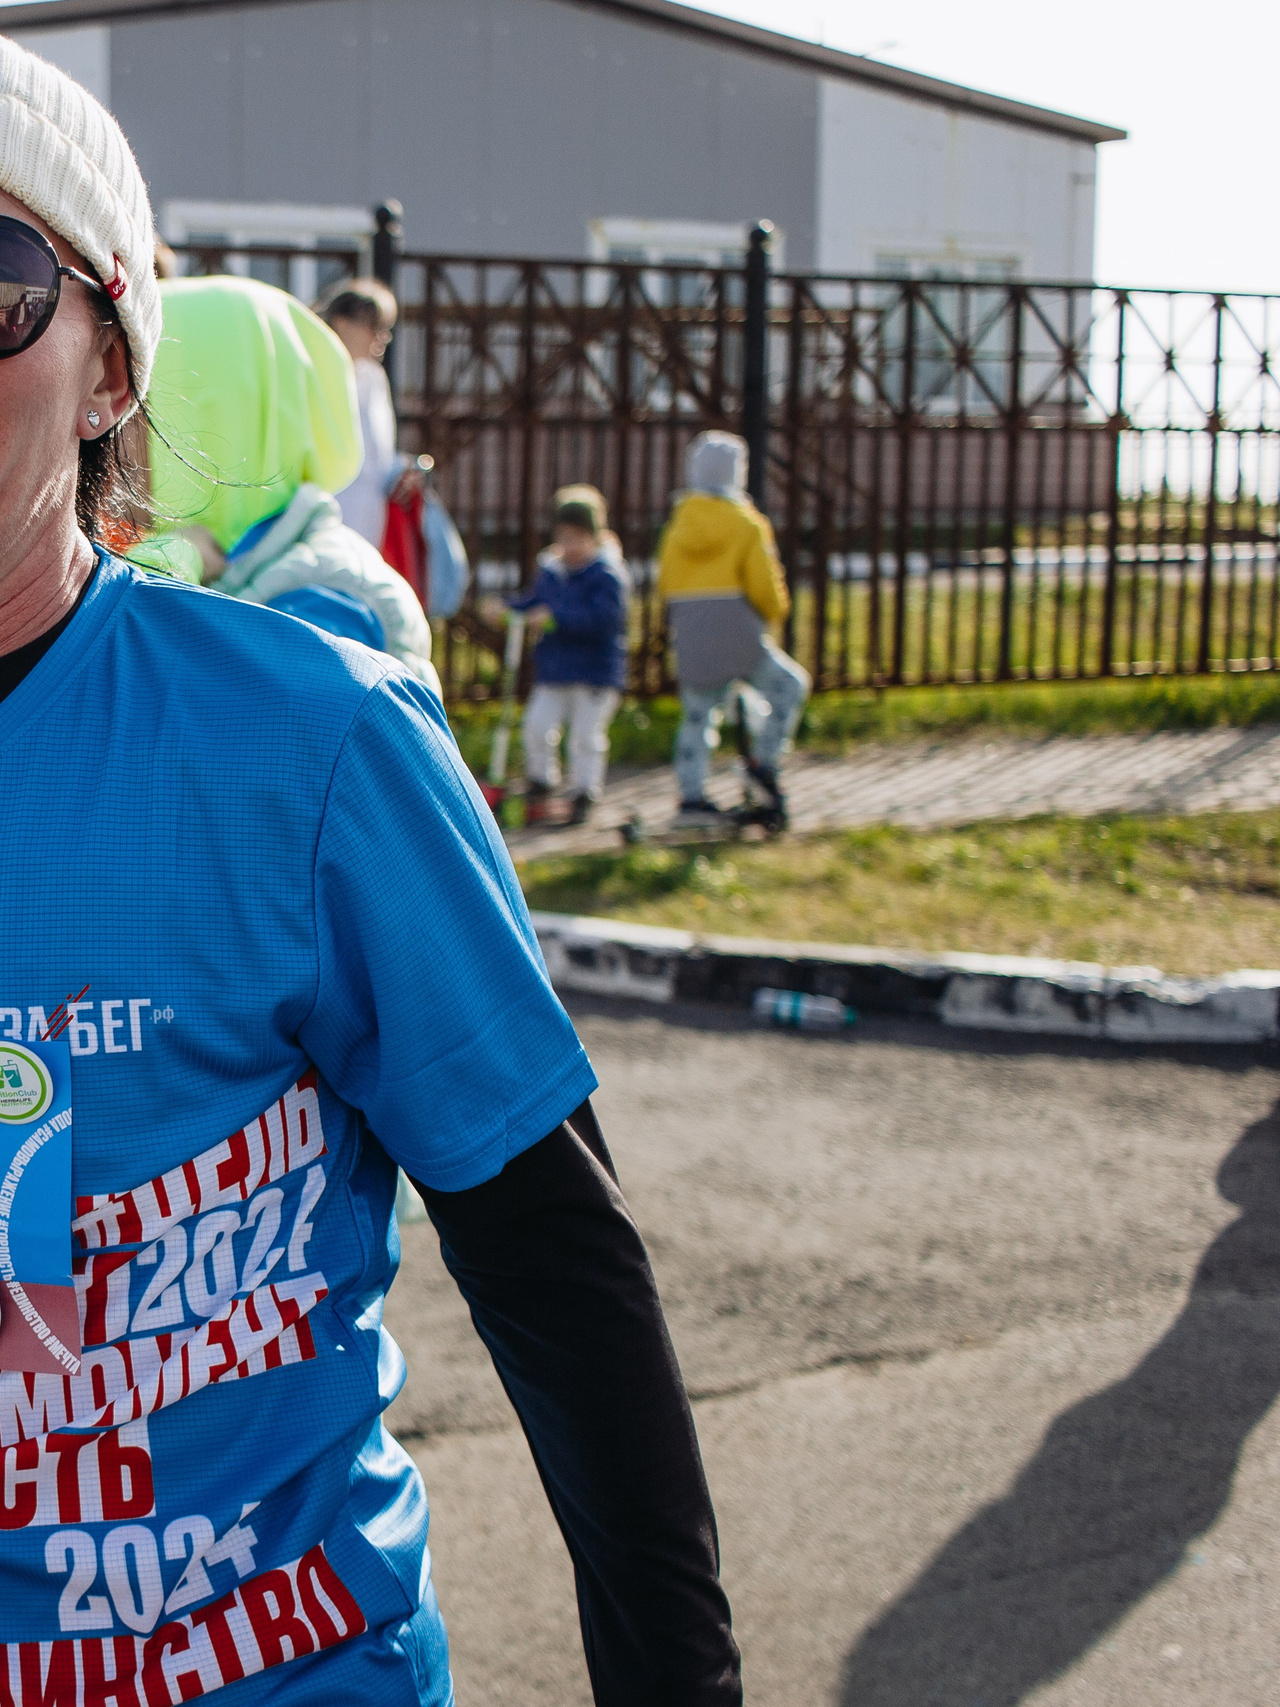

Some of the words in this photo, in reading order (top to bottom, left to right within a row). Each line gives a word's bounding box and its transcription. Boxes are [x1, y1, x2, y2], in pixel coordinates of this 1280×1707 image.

[47, 1106, 72, 1133] ОДА
[6, 1281, 51, 1340] #ЕДИНСТВО
[43, 1334, 81, 1375] #МЕЧТА
